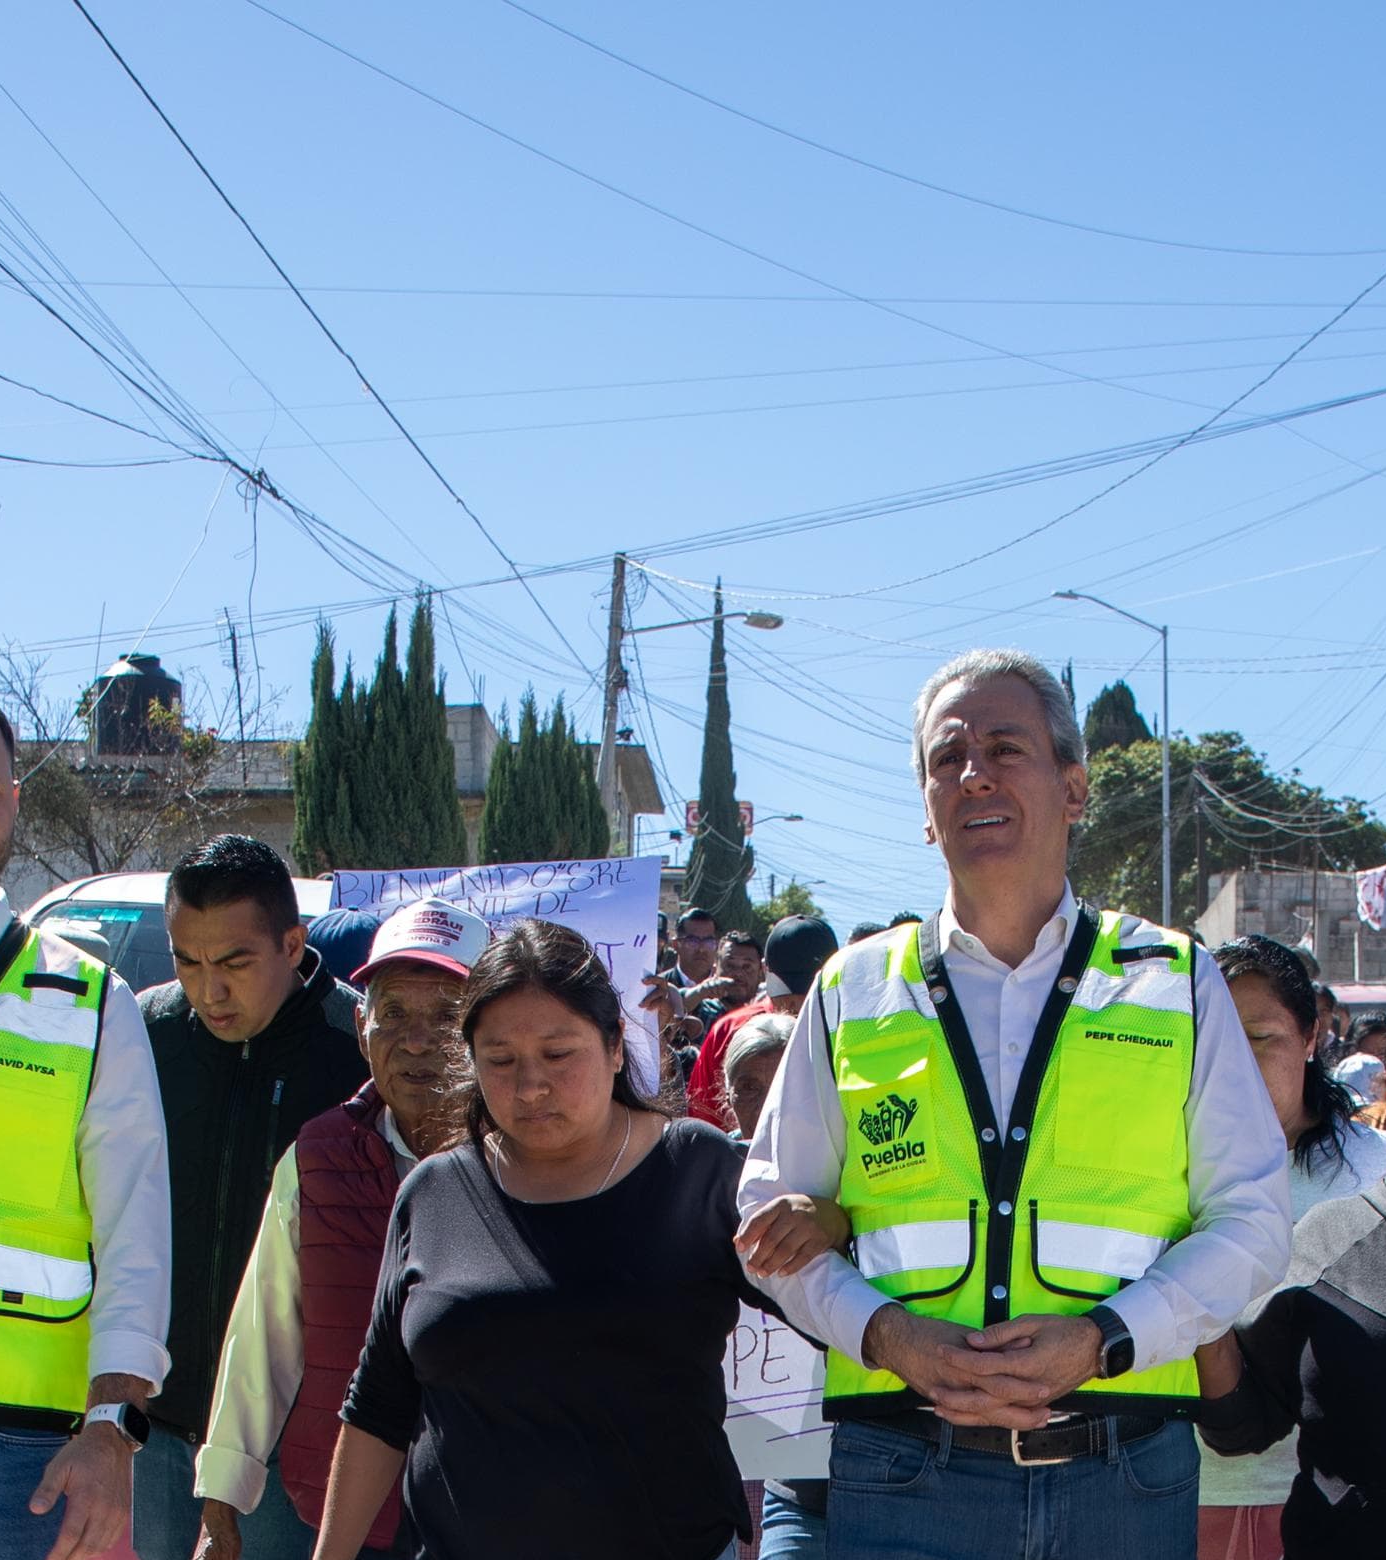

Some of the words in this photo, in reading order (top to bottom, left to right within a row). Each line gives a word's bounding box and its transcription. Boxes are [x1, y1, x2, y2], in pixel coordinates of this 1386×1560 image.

[335, 864, 557, 908] BIENVENIDO
[532, 890, 580, 916] DE
[1085, 1031, 1115, 1041] PEPE
[1116, 1033, 1173, 1048] CHEDRAUI
[25, 1063, 55, 1076] AYSA
[861, 1140, 925, 1172] Puebla
